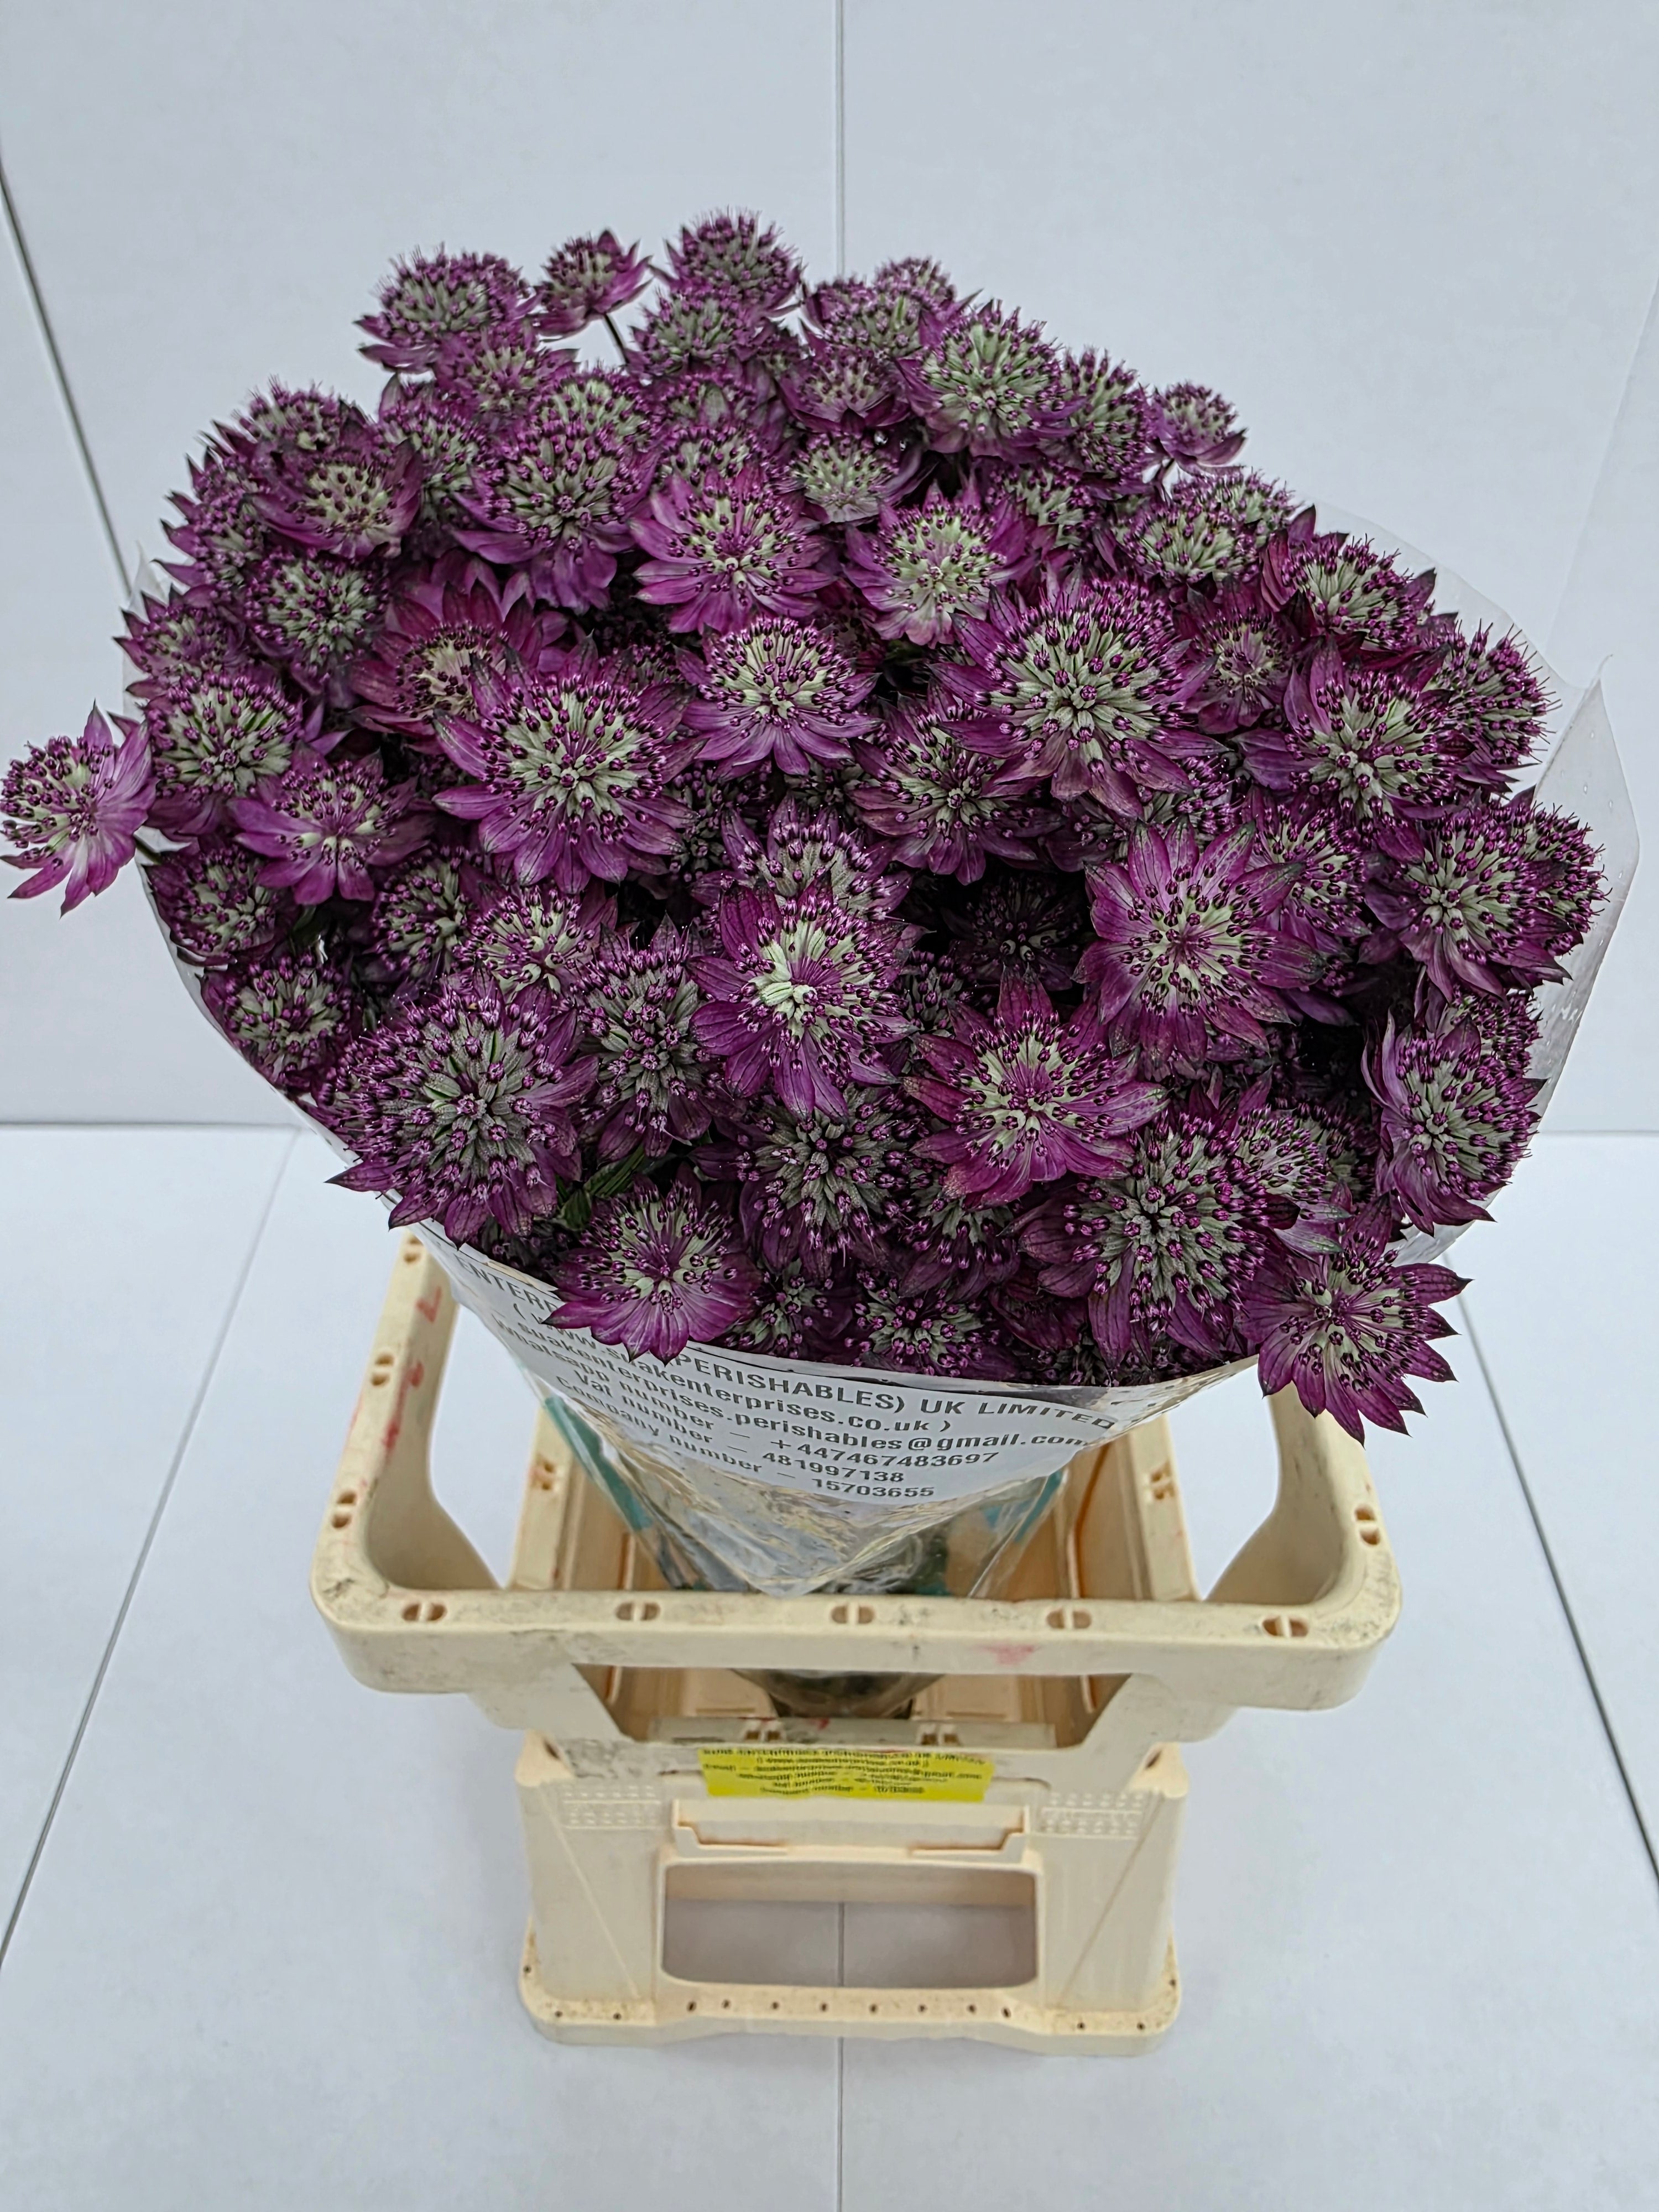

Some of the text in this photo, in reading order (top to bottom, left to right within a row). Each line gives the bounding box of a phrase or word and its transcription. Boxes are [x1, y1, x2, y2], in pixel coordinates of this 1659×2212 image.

[556, 1376, 659, 1436] Company
[669, 1434, 762, 1472] number
[812, 1478, 934, 1497] 15703655
[575, 1370, 613, 1397] Vat
[622, 1395, 712, 1443] number
[763, 1453, 904, 1482] 481997138
[619, 1381, 714, 1430] number
[670, 1354, 905, 1413] PERISHABLES)
[920, 1399, 965, 1414] UK
[978, 1402, 1115, 1428] LIMITED
